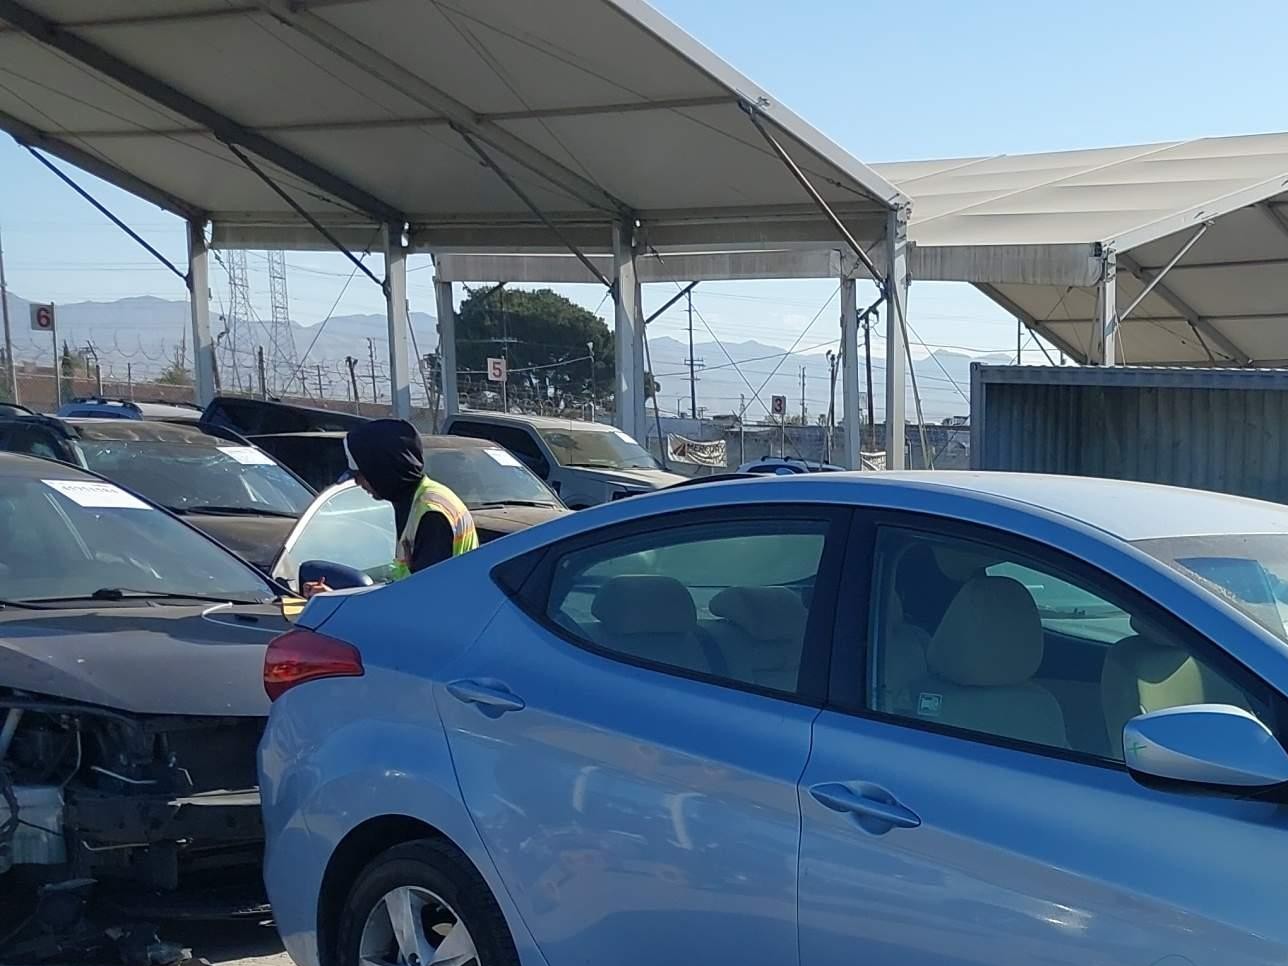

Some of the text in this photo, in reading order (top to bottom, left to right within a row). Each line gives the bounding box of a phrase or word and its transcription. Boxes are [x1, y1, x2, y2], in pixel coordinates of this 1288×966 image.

[37, 307, 50, 328] 6
[492, 361, 503, 378] 5
[774, 398, 783, 413] 3
